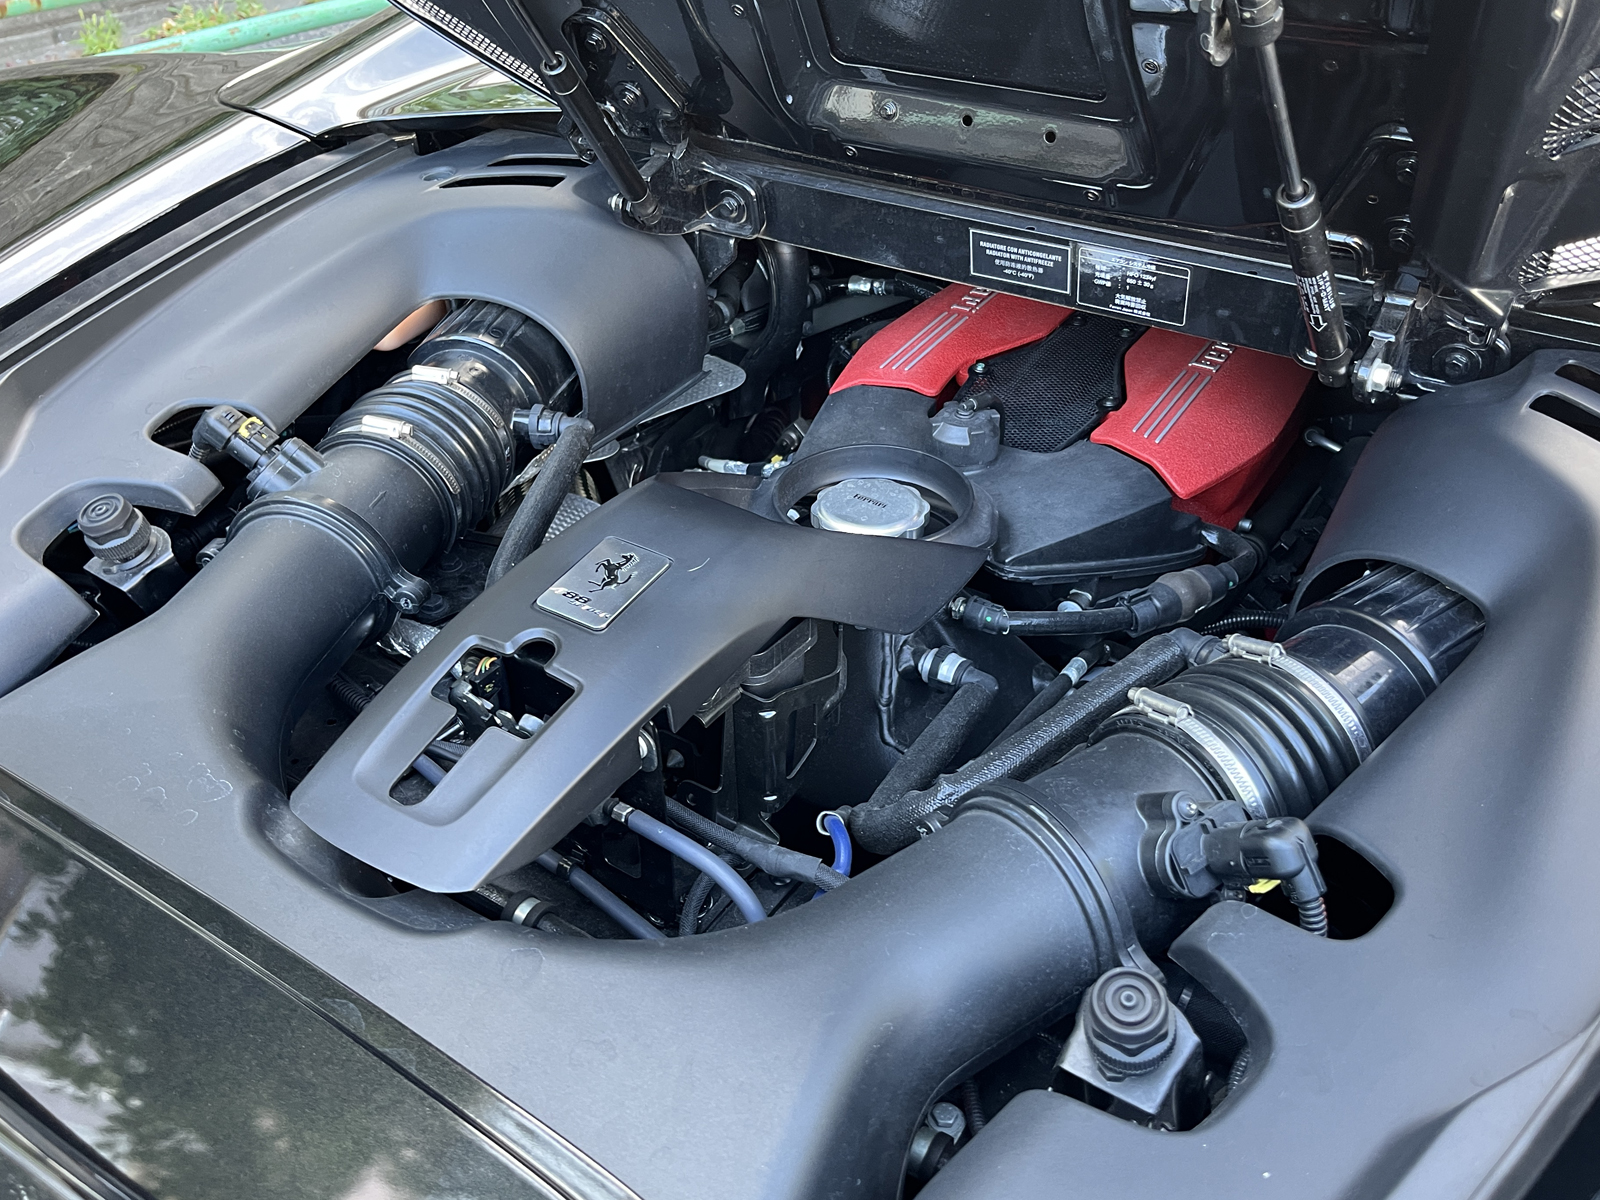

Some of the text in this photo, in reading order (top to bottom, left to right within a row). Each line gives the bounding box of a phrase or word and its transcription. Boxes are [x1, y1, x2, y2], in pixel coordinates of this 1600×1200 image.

[980, 241, 1062, 262] RADIATORE CON ANTICONGELANTE
[986, 249, 1010, 259] RADIATOR
[1024, 256, 1054, 267] ANTIFREEZE
